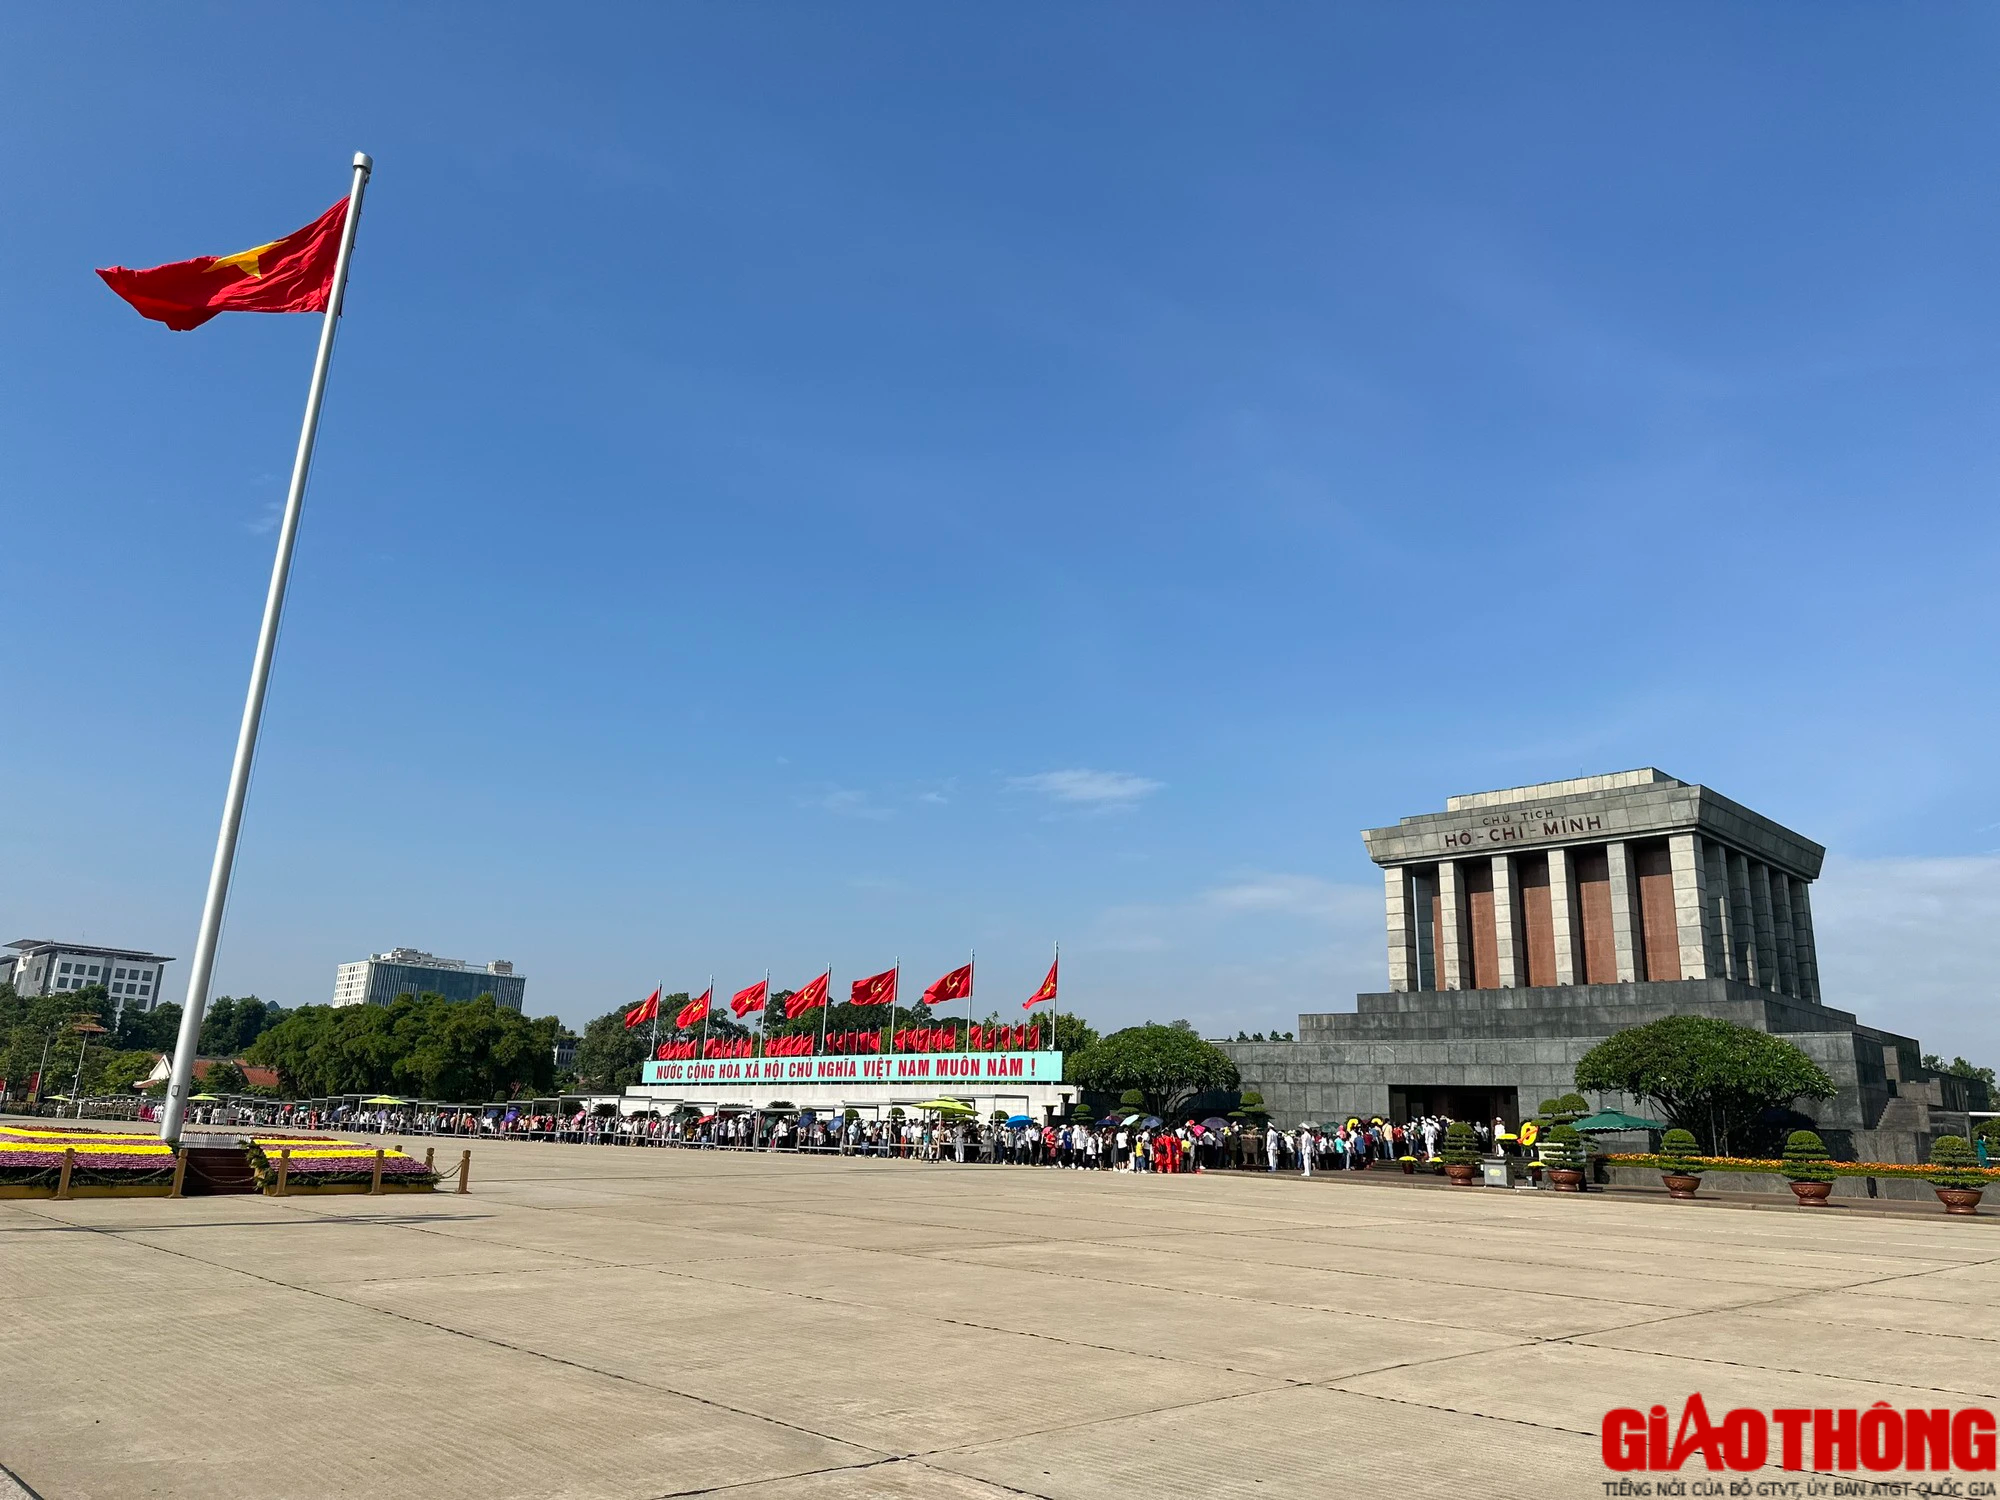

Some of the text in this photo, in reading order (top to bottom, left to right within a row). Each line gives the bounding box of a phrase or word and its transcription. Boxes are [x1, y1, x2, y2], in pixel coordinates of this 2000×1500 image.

[1543, 815, 1602, 836] MINH
[656, 1062, 683, 1079] NƯỚC
[687, 1061, 715, 1081] CỘNG
[719, 1060, 740, 1078] HÒA
[744, 1060, 759, 1078] XÃ
[764, 1059, 784, 1080] HỘI
[788, 1057, 813, 1077] CHỦ
[817, 1058, 857, 1077] NGHĨA
[863, 1056, 892, 1080] VIỆT
[898, 1059, 930, 1076] NAM
[936, 1055, 980, 1076] MUÔN
[987, 1054, 1023, 1076] NĂM
